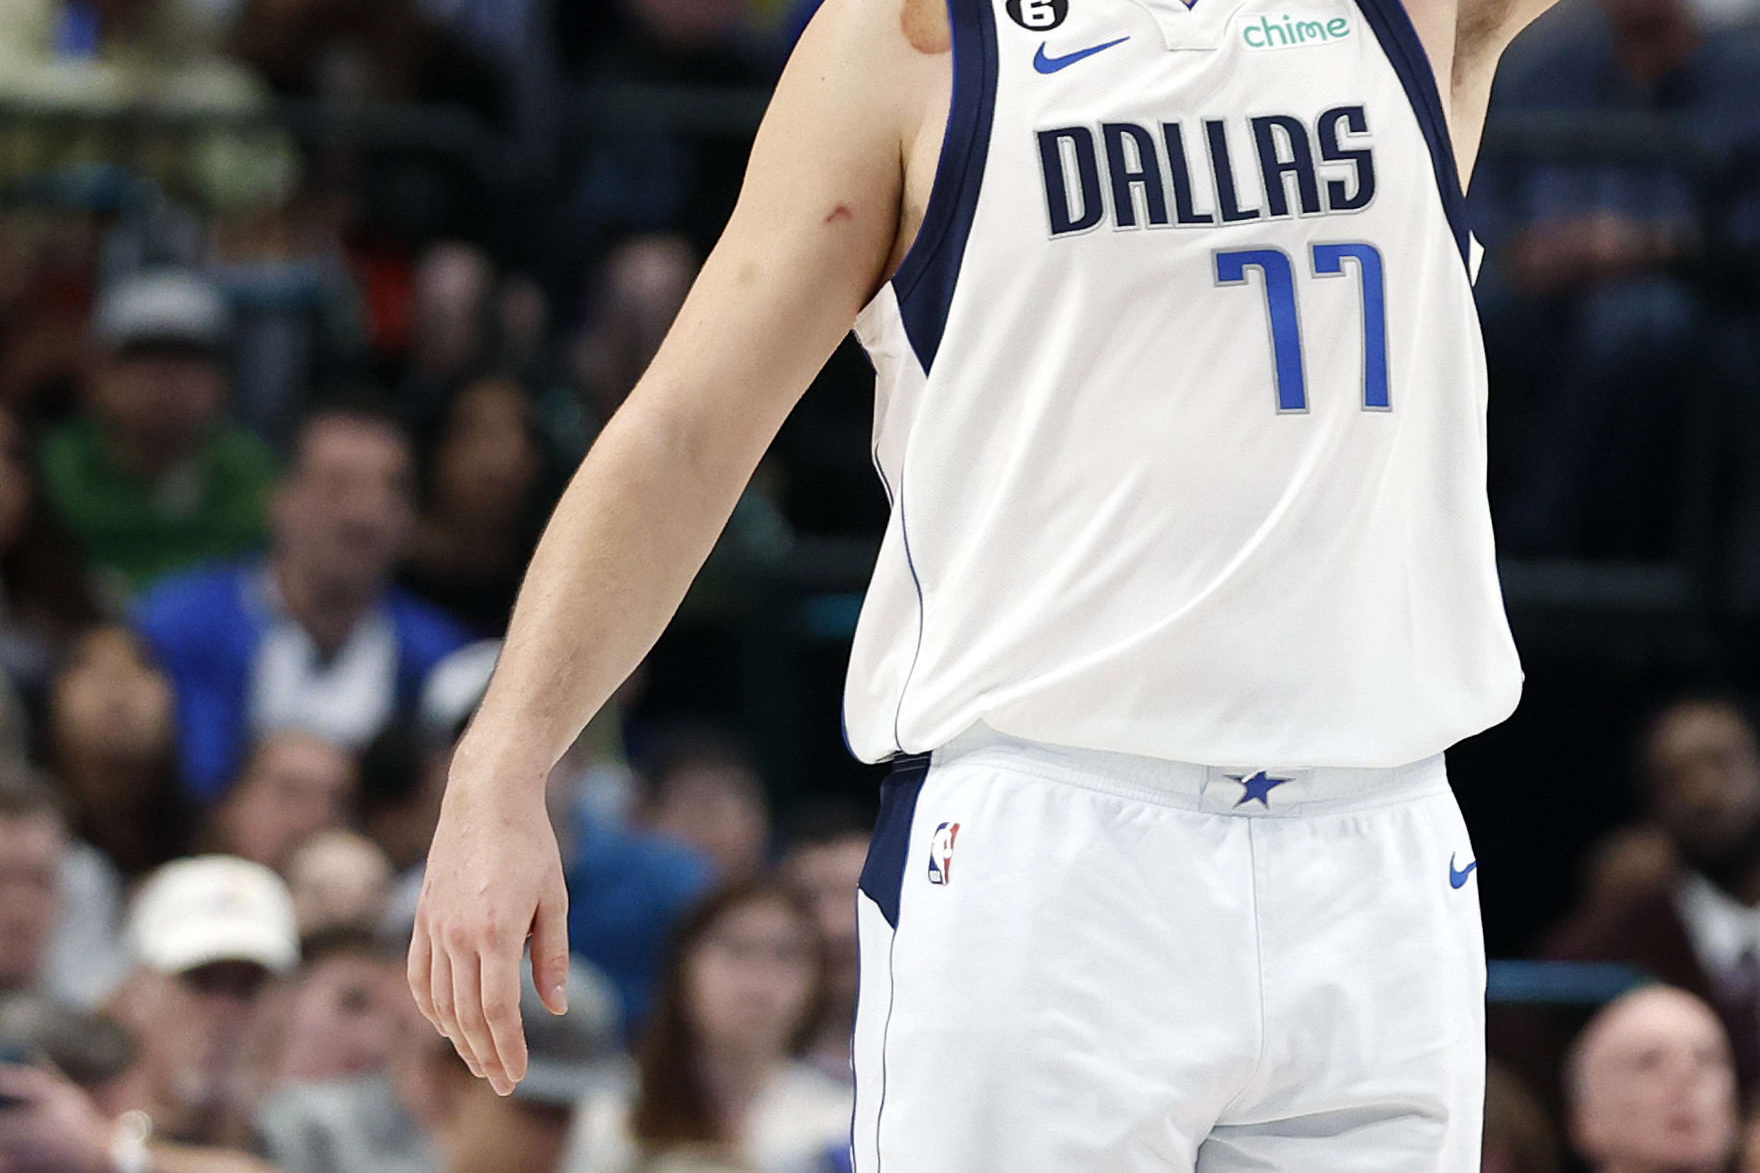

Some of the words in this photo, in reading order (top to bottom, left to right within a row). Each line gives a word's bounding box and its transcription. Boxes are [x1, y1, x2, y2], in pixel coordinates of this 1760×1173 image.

[1243, 14, 1350, 48] chime
[1033, 102, 1376, 241] DALLAS
[1211, 240, 1393, 415] 77
